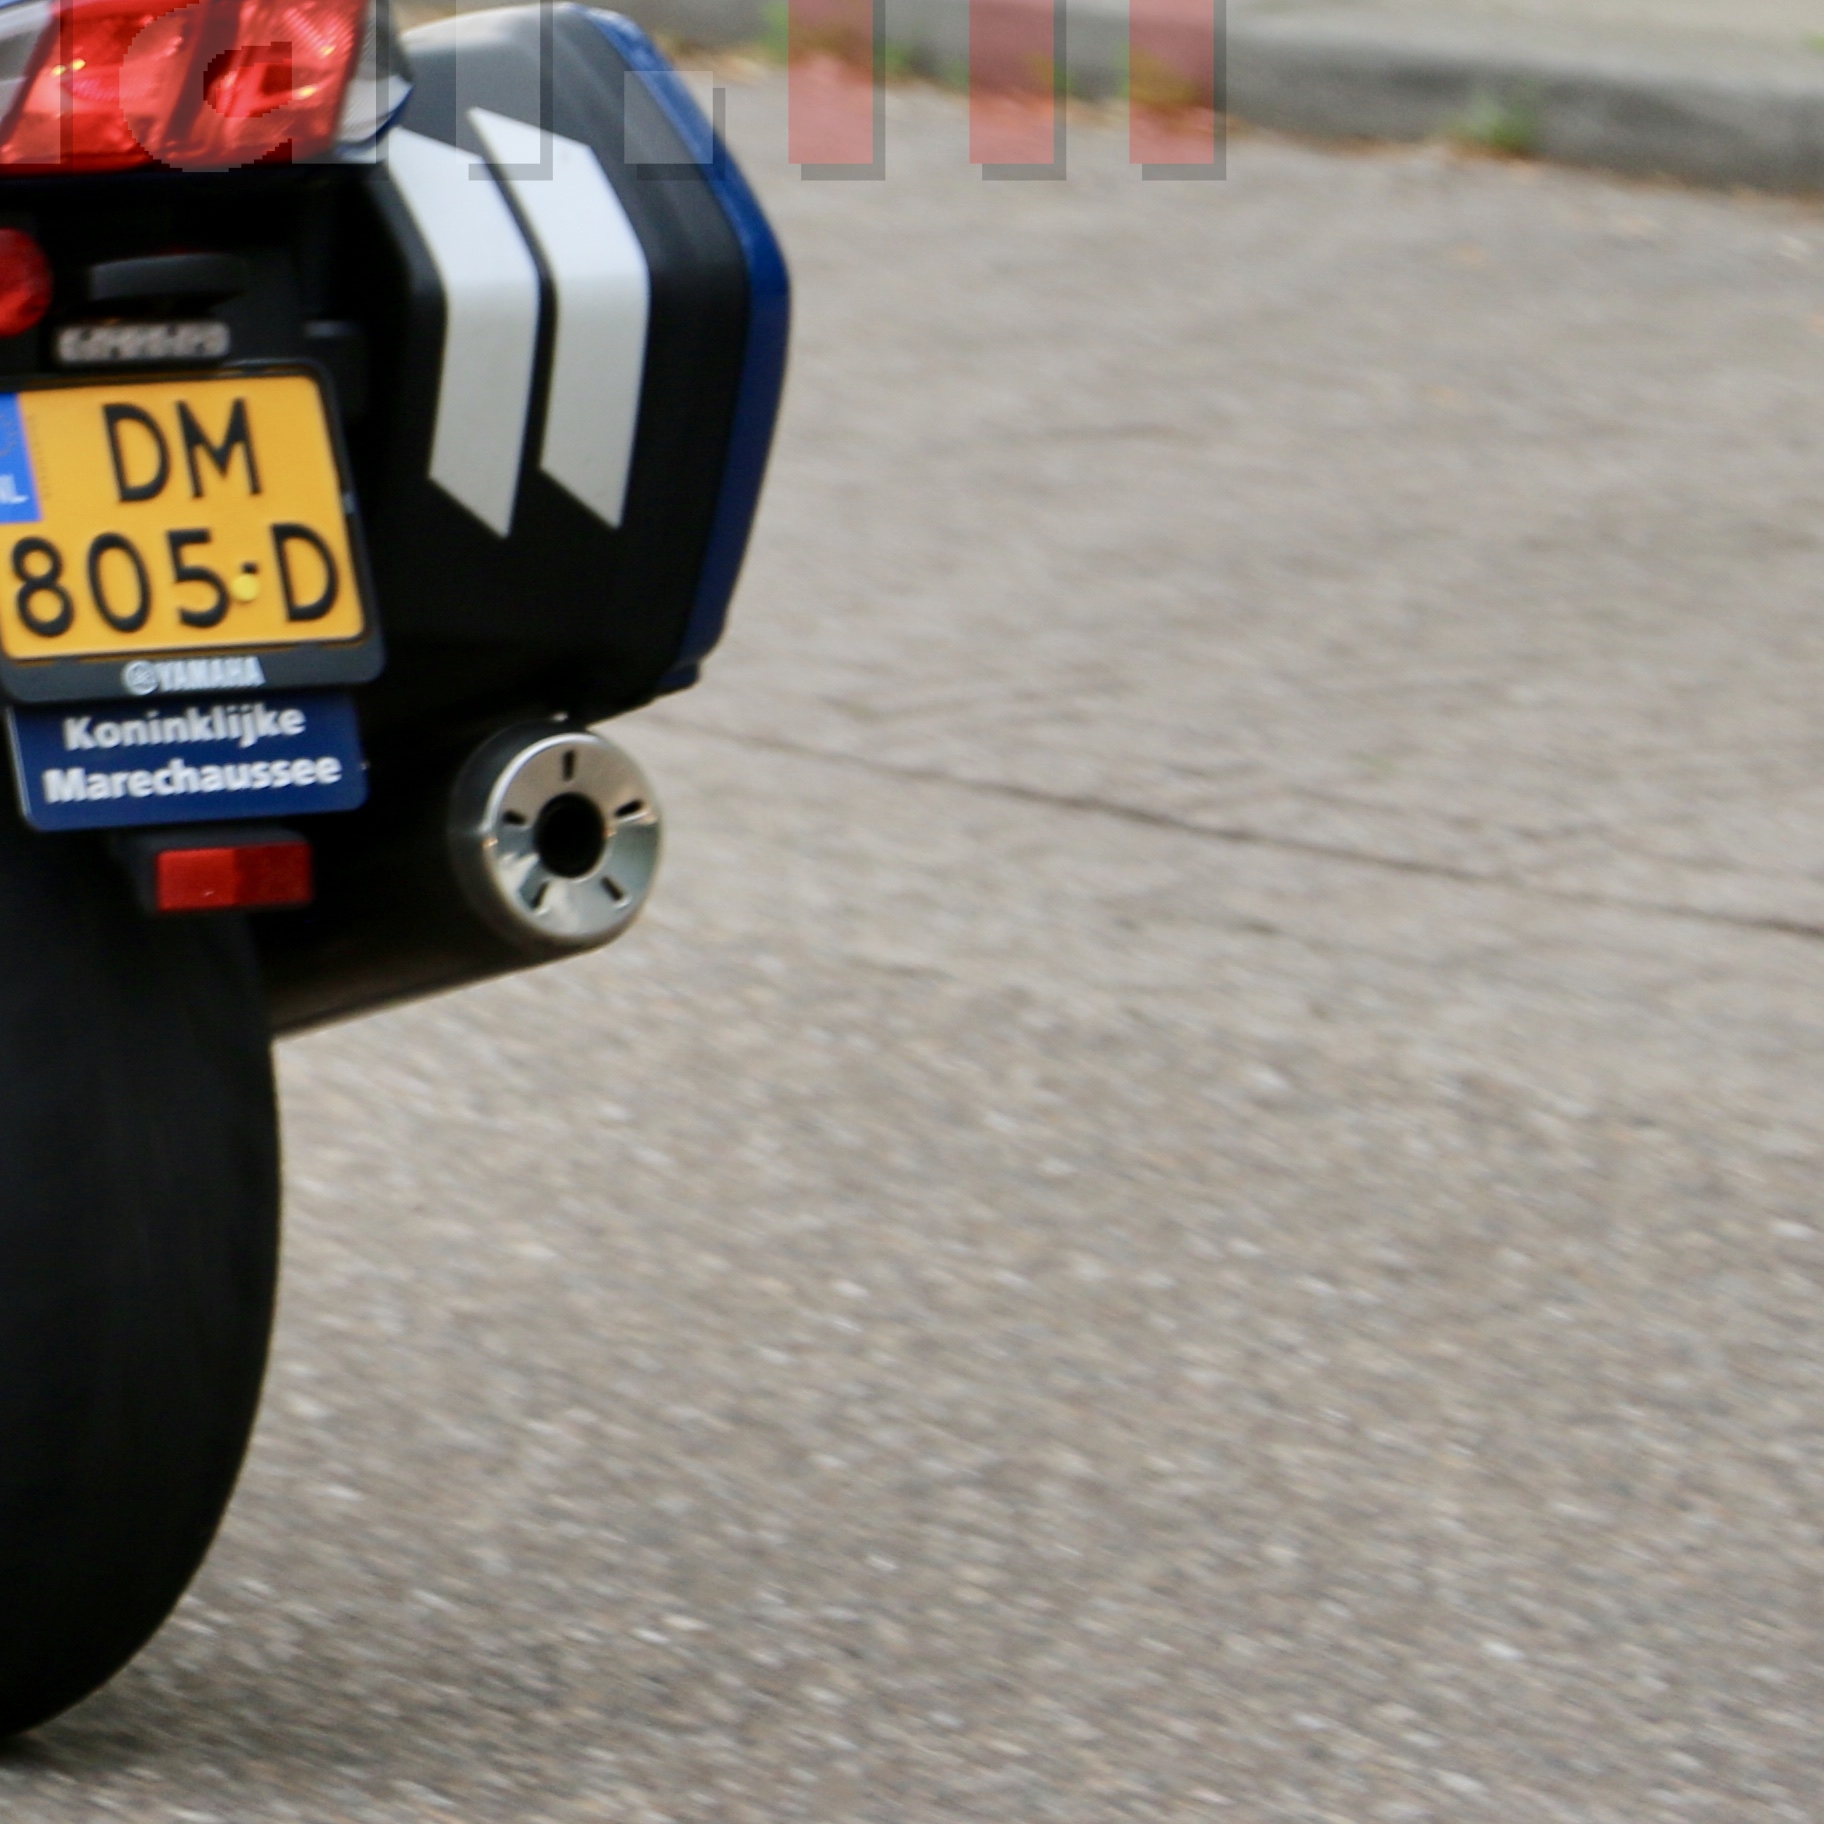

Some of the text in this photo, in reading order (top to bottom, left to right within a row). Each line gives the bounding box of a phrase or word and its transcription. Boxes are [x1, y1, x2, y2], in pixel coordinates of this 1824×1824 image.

[101, 397, 264, 503] DM
[62, 702, 307, 750] Koninklijke
[41, 756, 343, 804] Marechaussee
